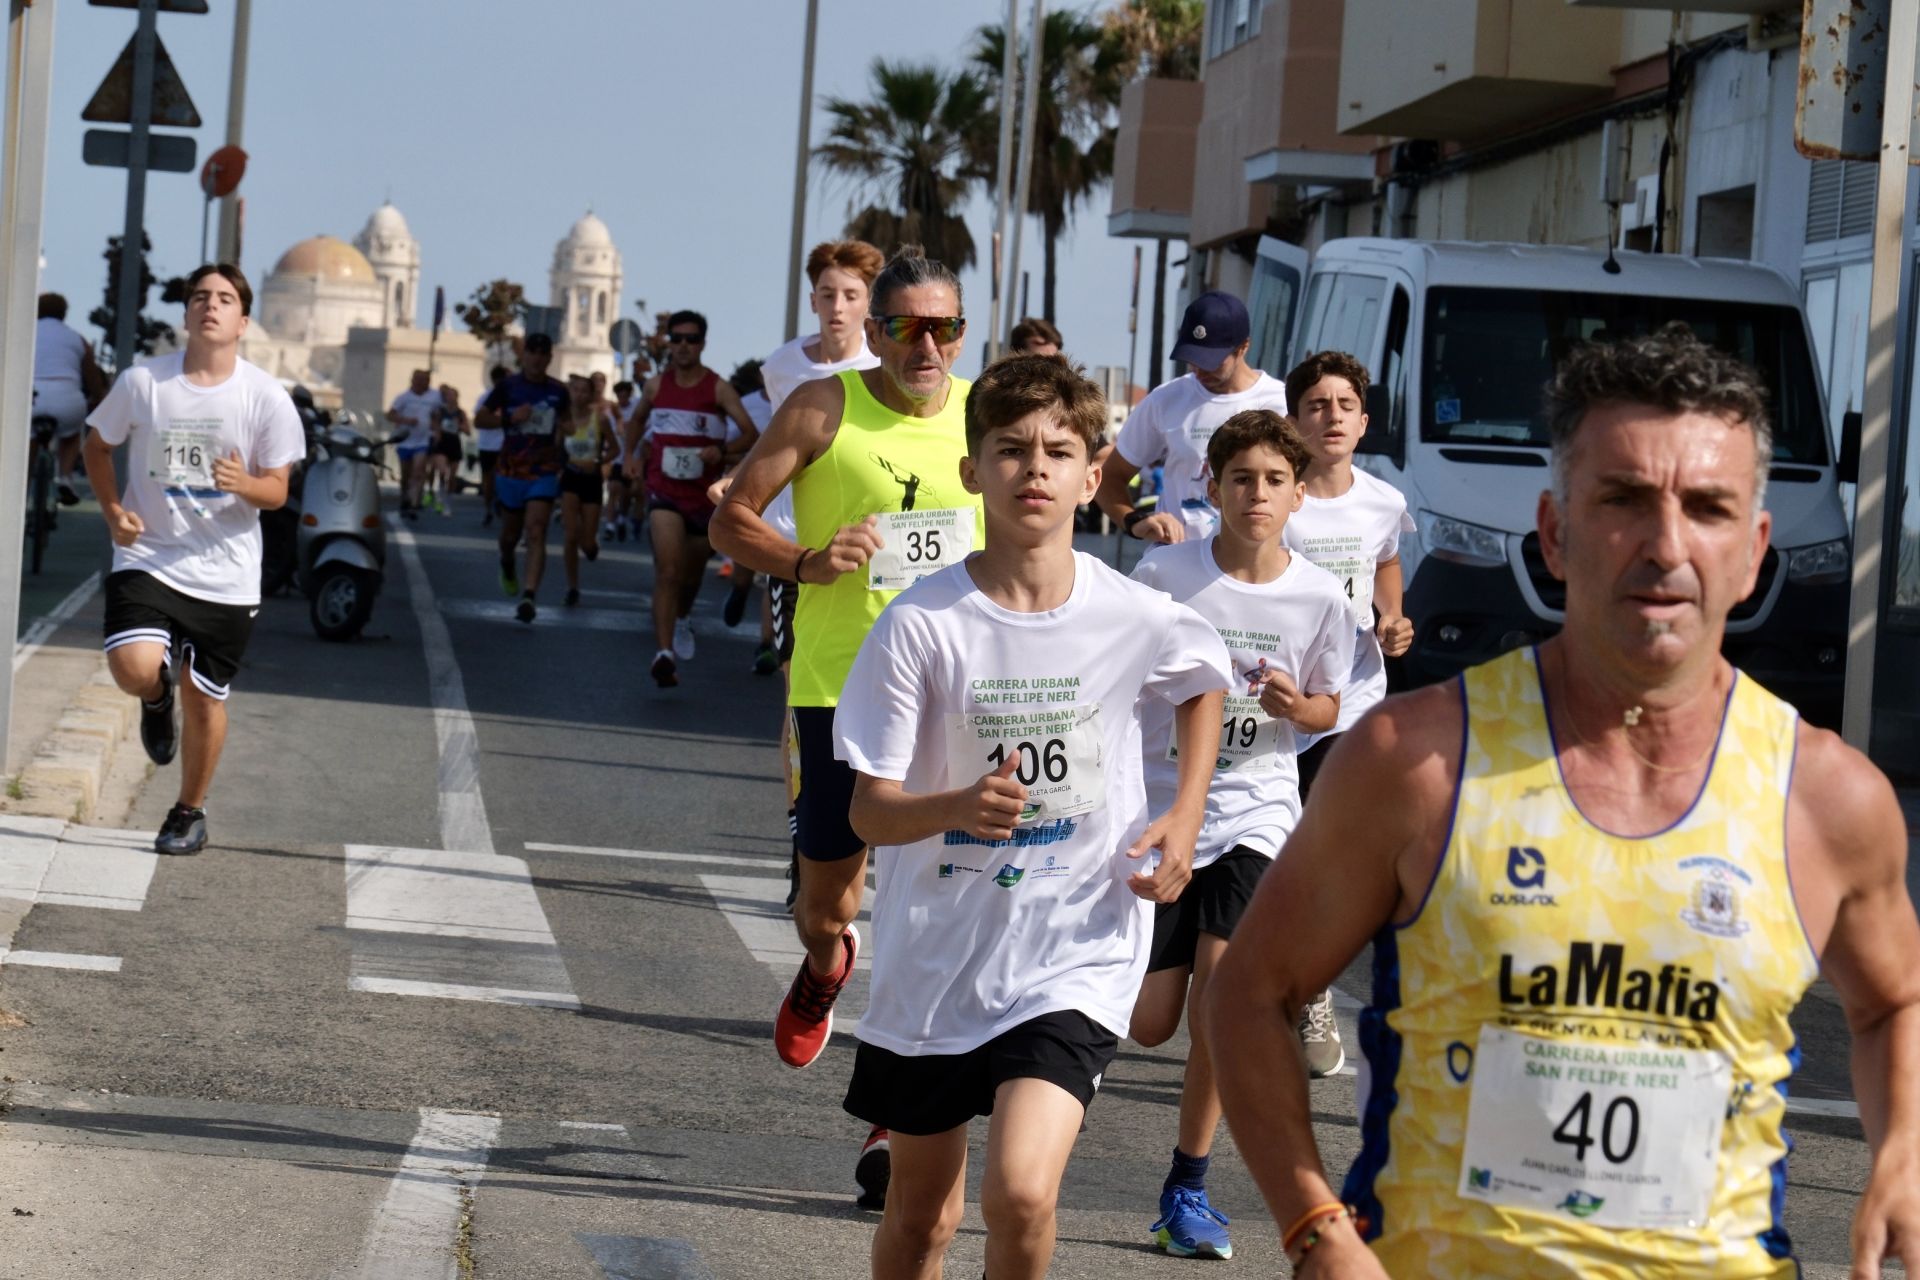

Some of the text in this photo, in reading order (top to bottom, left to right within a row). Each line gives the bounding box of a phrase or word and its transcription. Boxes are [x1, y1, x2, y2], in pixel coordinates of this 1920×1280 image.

[164, 445, 202, 467] 116
[675, 455, 690, 469] 75
[890, 510, 957, 521] CARRERA URBANA
[892, 519, 955, 529] SAN FELIPE NERI
[906, 530, 941, 562] 35
[1245, 631, 1281, 643] URBANA
[1225, 640, 1278, 652] FELIPE NERI
[972, 677, 1080, 690] CARRERA URBANA
[974, 690, 1076, 704] SAN FELIPE NERI
[974, 710, 1076, 725] CARRERA URBANA
[978, 722, 1073, 738] SAN FELIPE NERI
[1223, 716, 1257, 748] 19
[987, 738, 1068, 786] 106
[1029, 784, 1071, 796] ELETA GARCÍA
[1607, 1028, 1618, 1038] A
[1625, 1030, 1648, 1040] LA
[1524, 1041, 1686, 1069] CARRERA URBANA
[1525, 1062, 1679, 1090] SAN FELIPE NERI
[1552, 1091, 1640, 1164] 40
